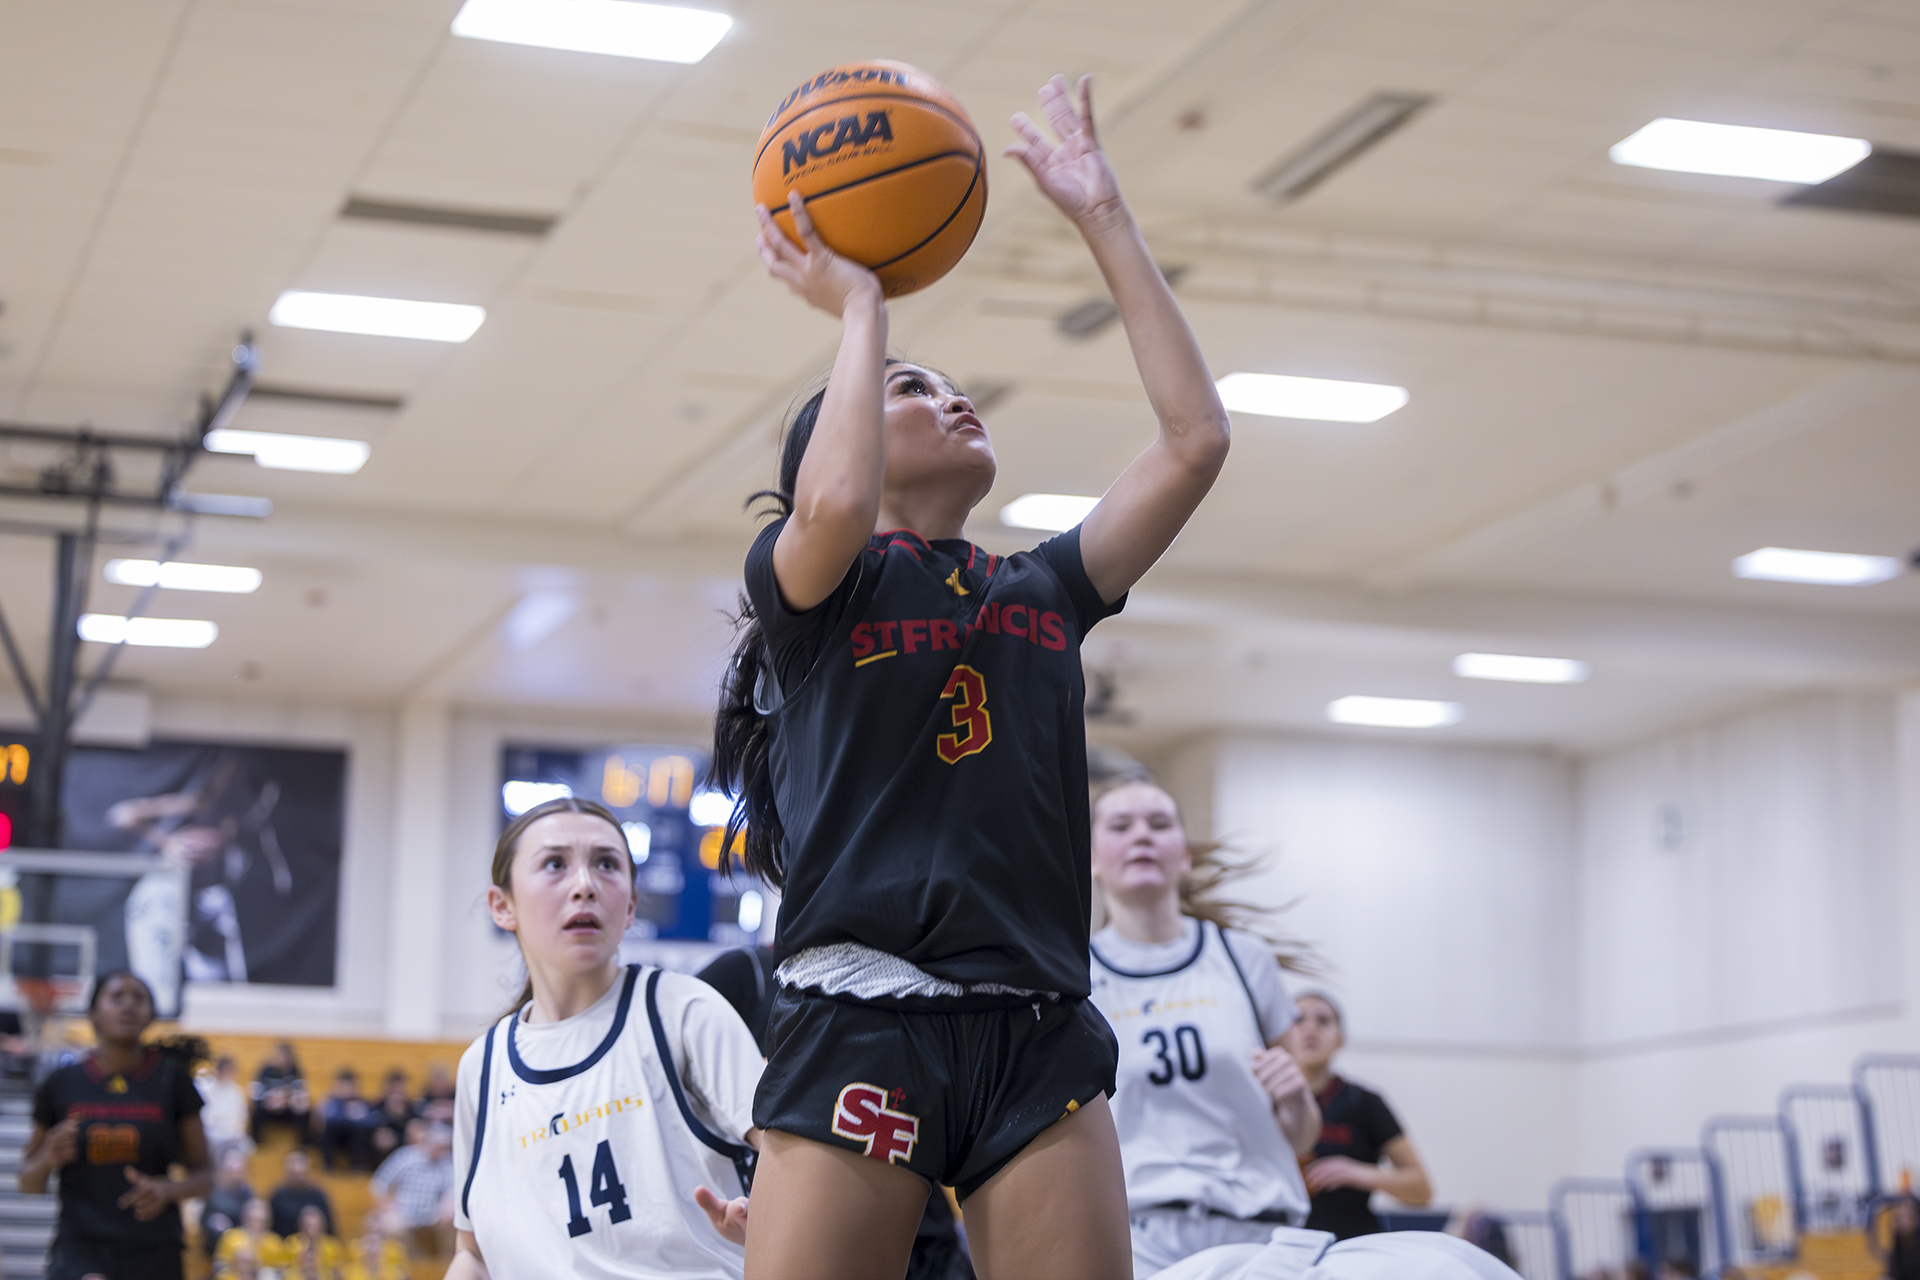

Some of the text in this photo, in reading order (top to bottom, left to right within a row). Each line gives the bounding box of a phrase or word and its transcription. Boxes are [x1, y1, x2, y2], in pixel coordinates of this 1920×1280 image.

[782, 109, 893, 177] NCAA
[936, 664, 993, 765] 3
[1142, 1025, 1206, 1085] 30
[517, 1092, 643, 1149] TROJANS
[831, 1081, 920, 1165] SF
[558, 1138, 632, 1238] 14
